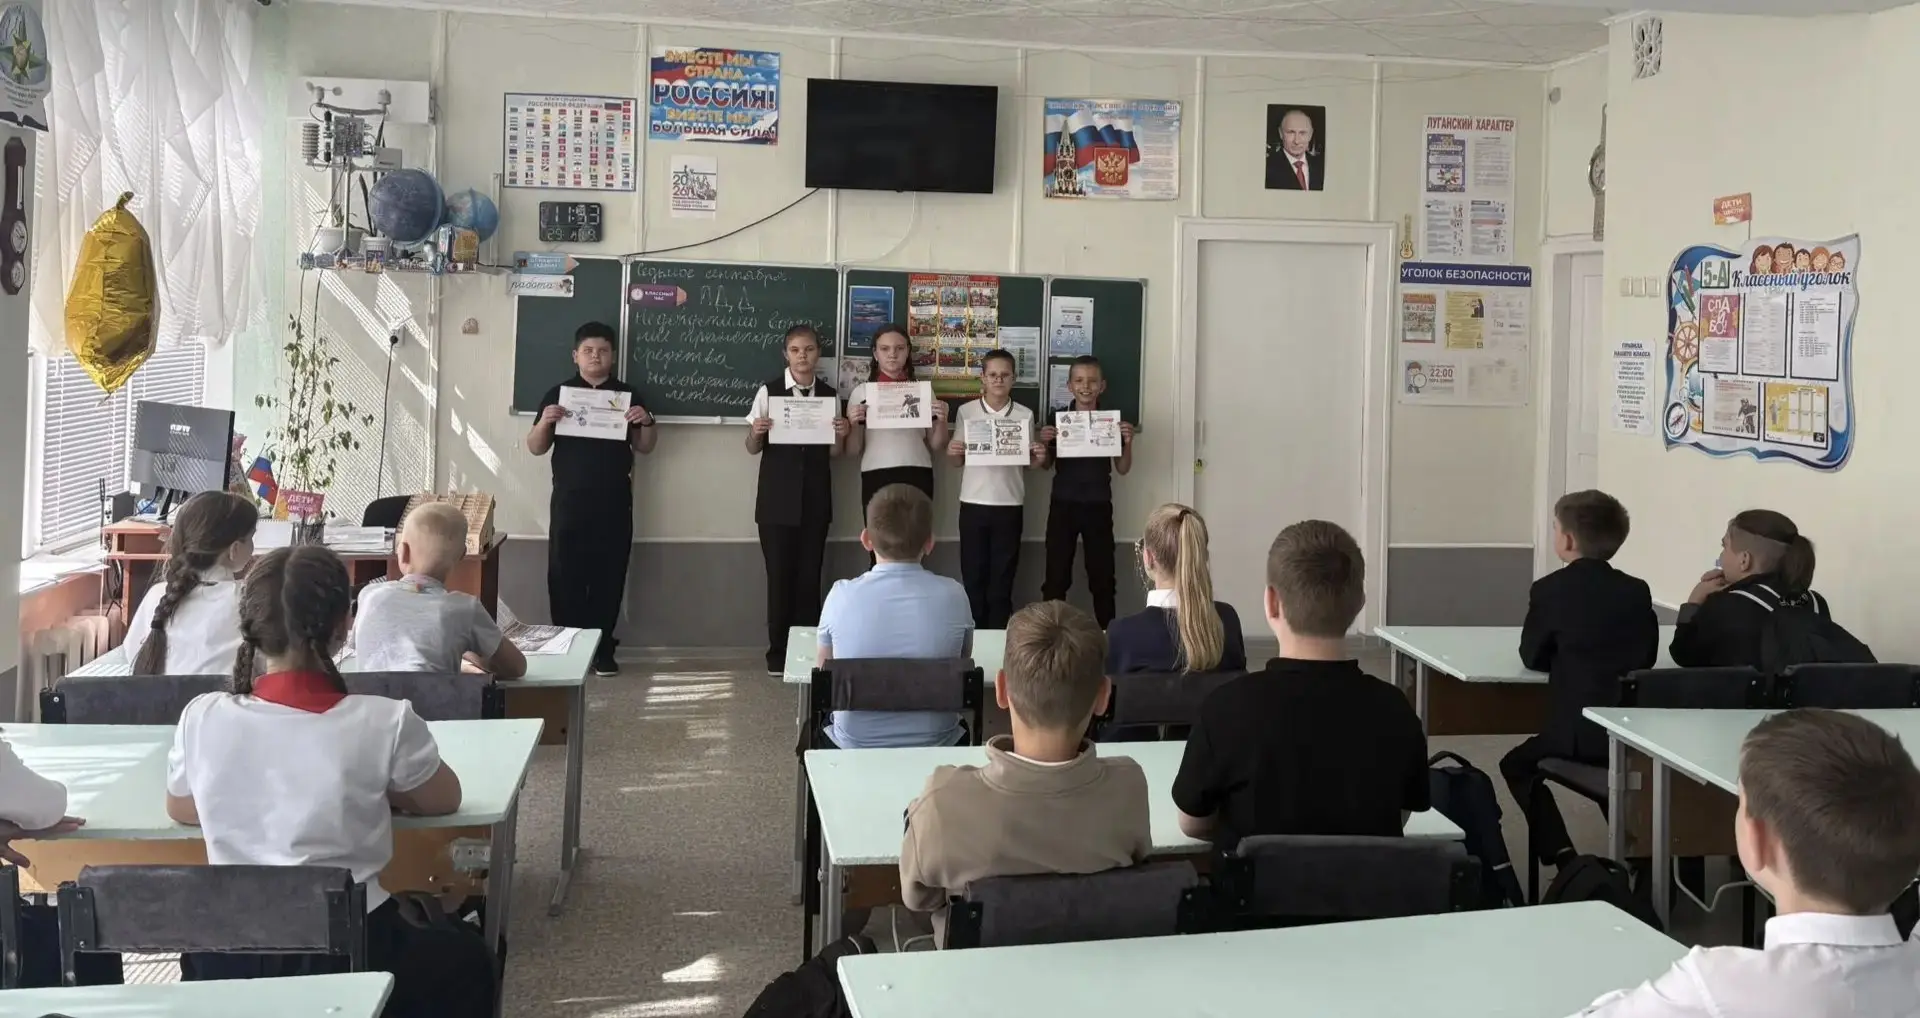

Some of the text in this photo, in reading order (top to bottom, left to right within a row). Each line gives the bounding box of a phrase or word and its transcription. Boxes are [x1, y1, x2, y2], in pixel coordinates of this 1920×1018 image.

[664, 49, 724, 66] ВМЕСТЕ
[684, 65, 744, 80] СТРАНА
[653, 78, 777, 110] РОССИЯ!
[666, 108, 724, 122] ВМЕСТЕ
[652, 120, 777, 138] БОЛЬШАЯ СИЛА!
[1427, 116, 1515, 132] ЛУГАНСКИЙ ХАРАКТЕР
[672, 174, 688, 186] 20
[672, 185, 689, 197] 26
[1720, 198, 1743, 209] ДЕТИ
[1401, 267, 1531, 282] УГОЛОК БЕЗОПАСНОСТИ
[1731, 268, 1851, 291] Классный уголок
[1429, 368, 1454, 378] 22:00
[287, 494, 314, 504] ДЕТИ
